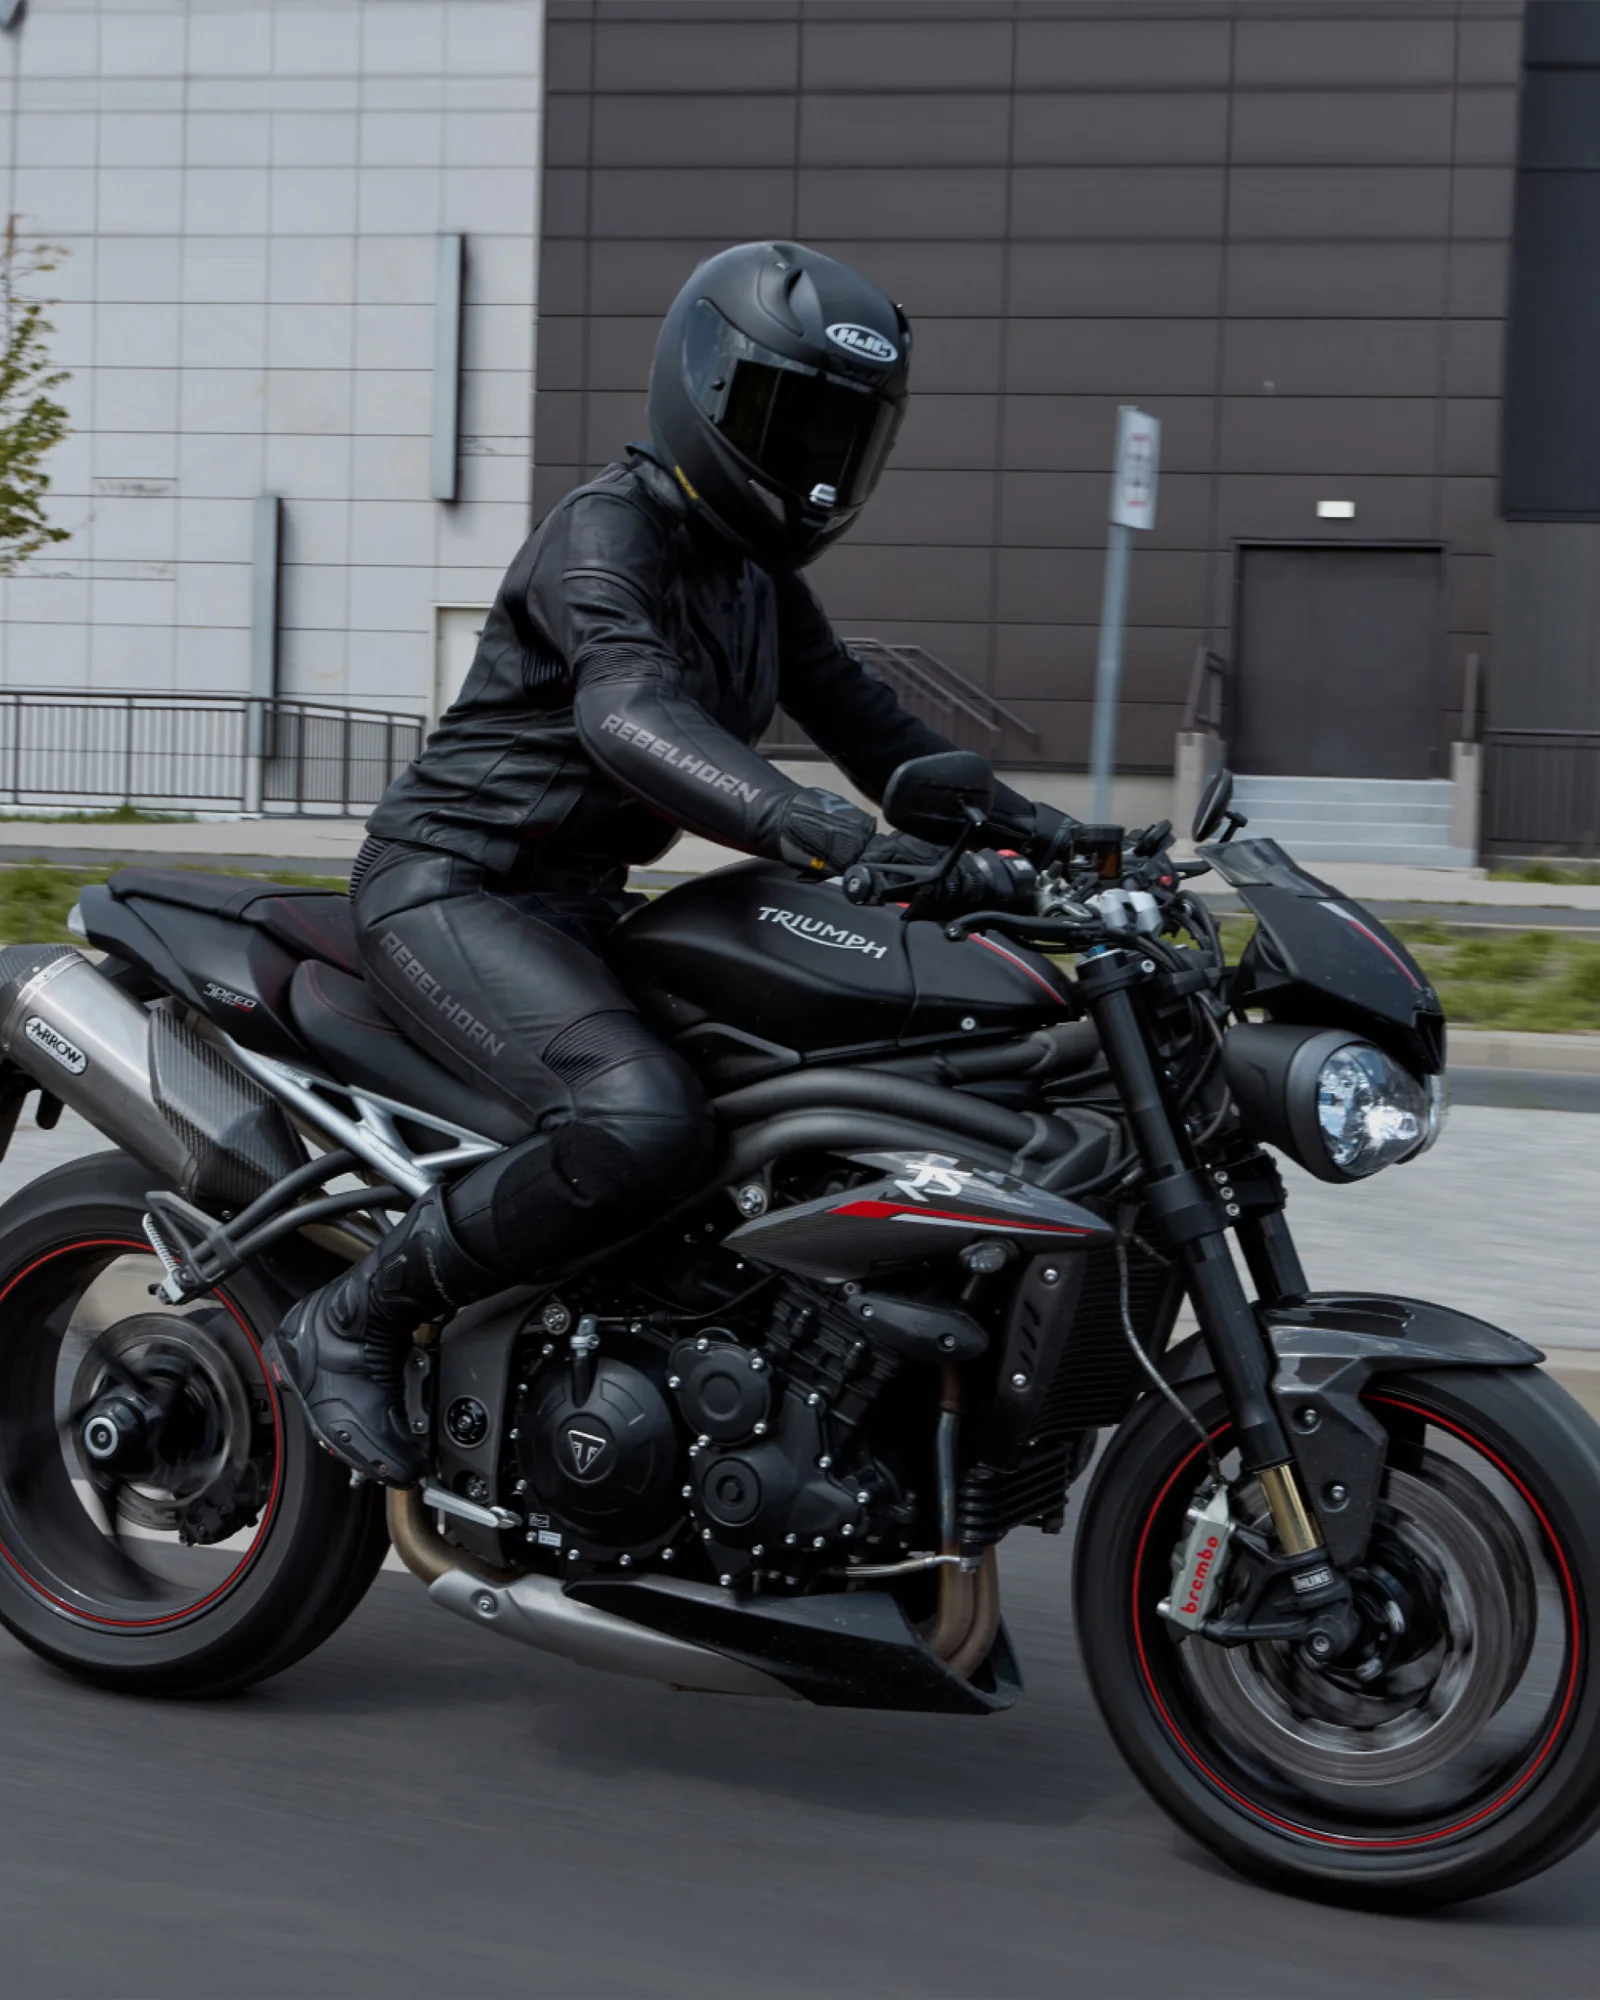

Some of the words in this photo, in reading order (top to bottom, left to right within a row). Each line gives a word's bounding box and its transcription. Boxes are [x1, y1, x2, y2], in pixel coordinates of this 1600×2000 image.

[834, 327, 892, 357] HJC
[600, 713, 762, 803] REBELHORN
[758, 906, 888, 959] TRIUMPH
[379, 930, 506, 1057] REBELHORN
[31, 1022, 82, 1064] ARROW
[1180, 1536, 1220, 1614] brembo
